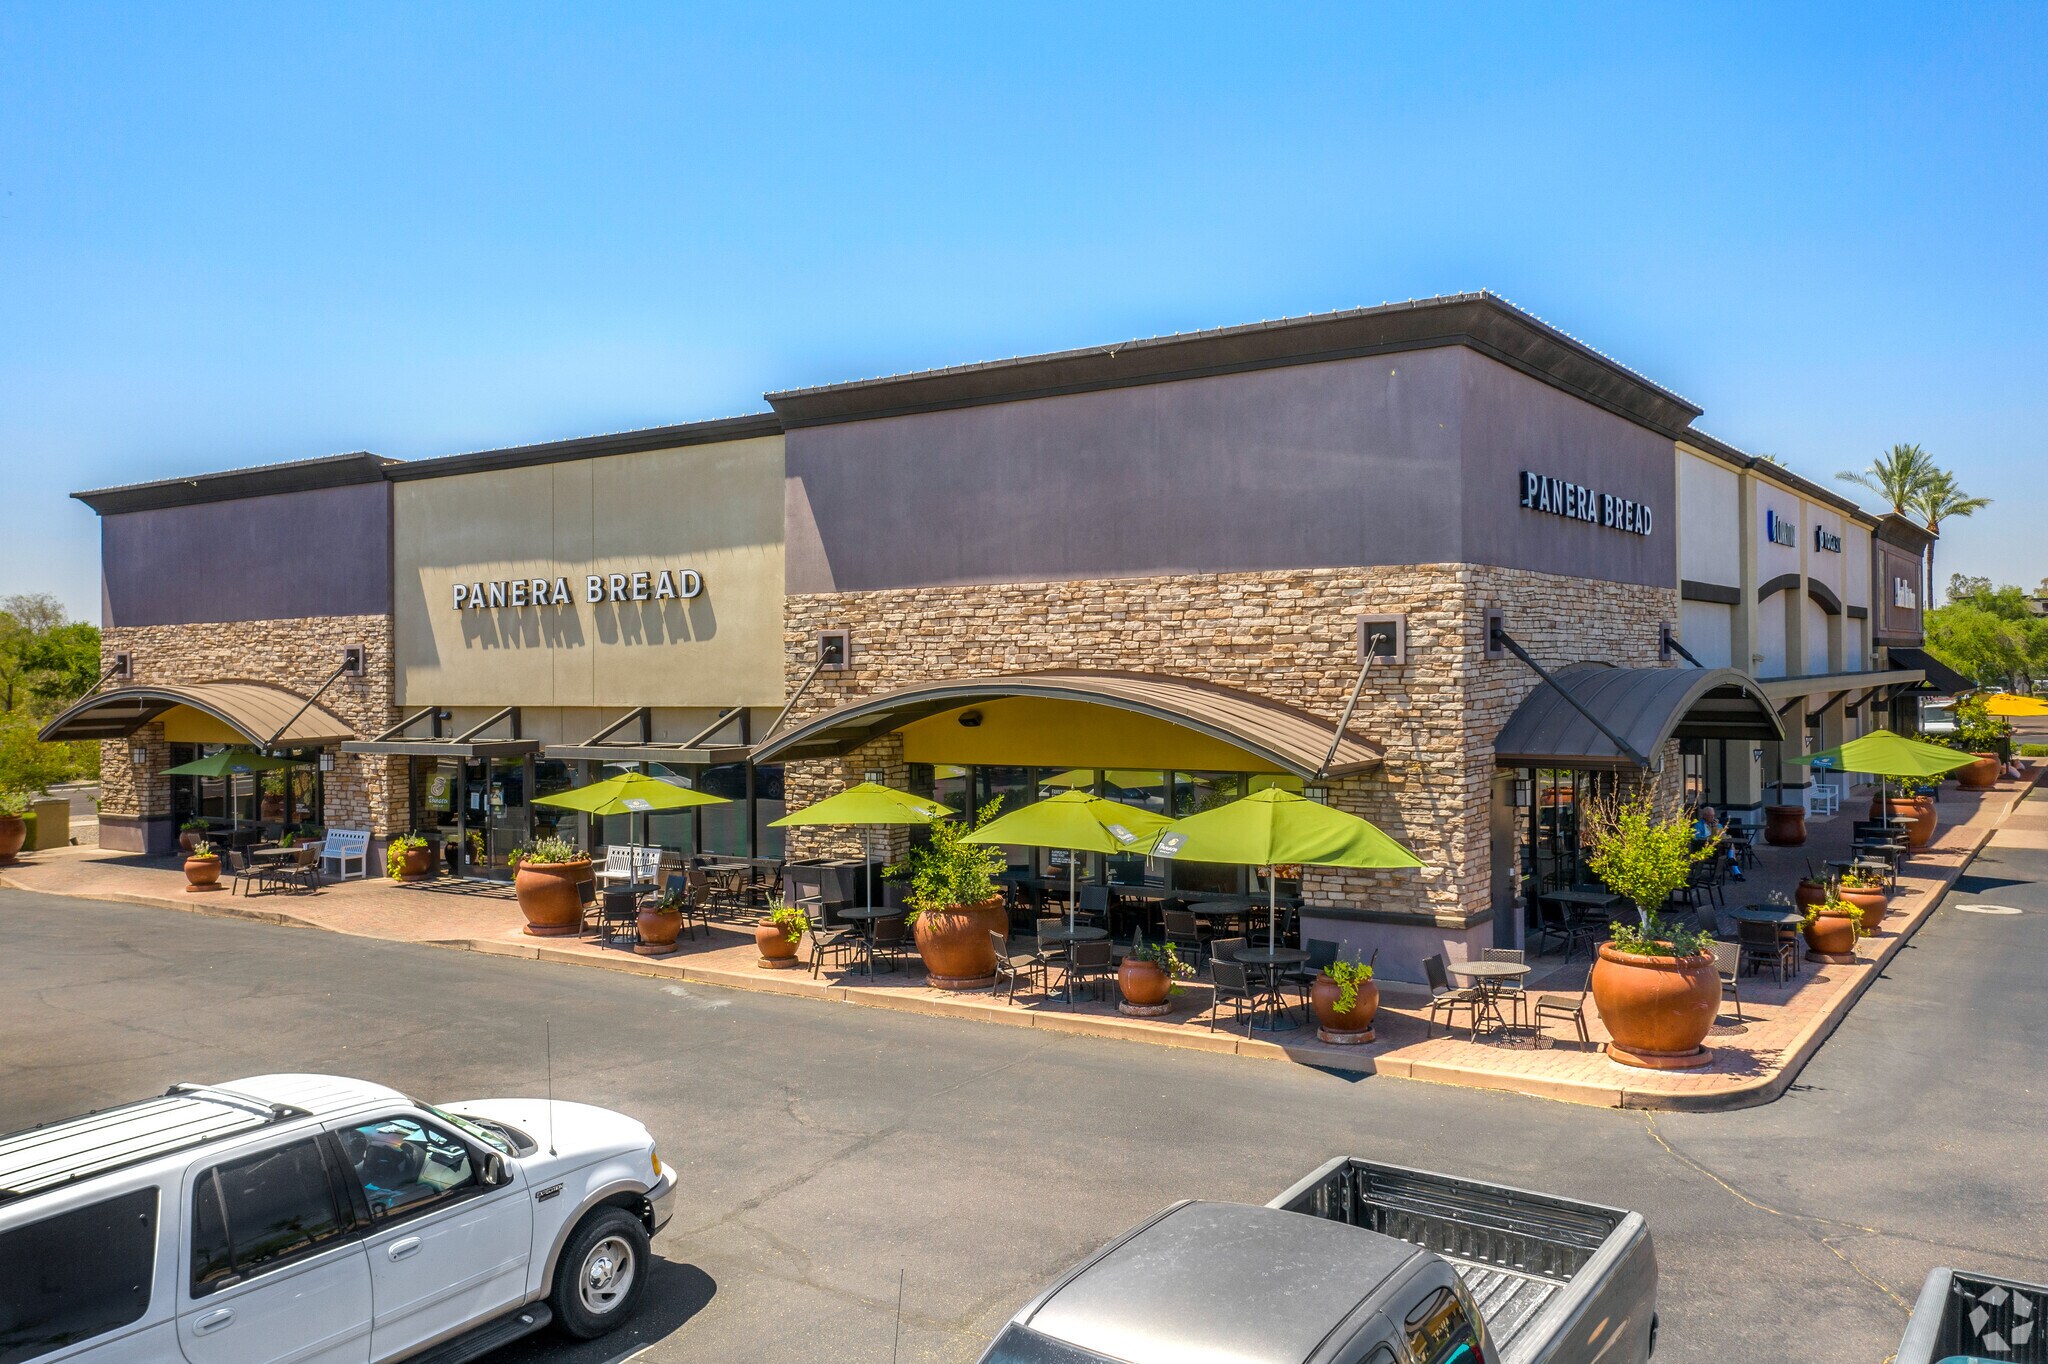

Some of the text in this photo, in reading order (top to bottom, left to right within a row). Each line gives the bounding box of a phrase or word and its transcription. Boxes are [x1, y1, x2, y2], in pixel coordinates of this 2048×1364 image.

[1521, 471, 1652, 536] PANERA BREAD
[452, 569, 704, 610] PANERA BREAD
